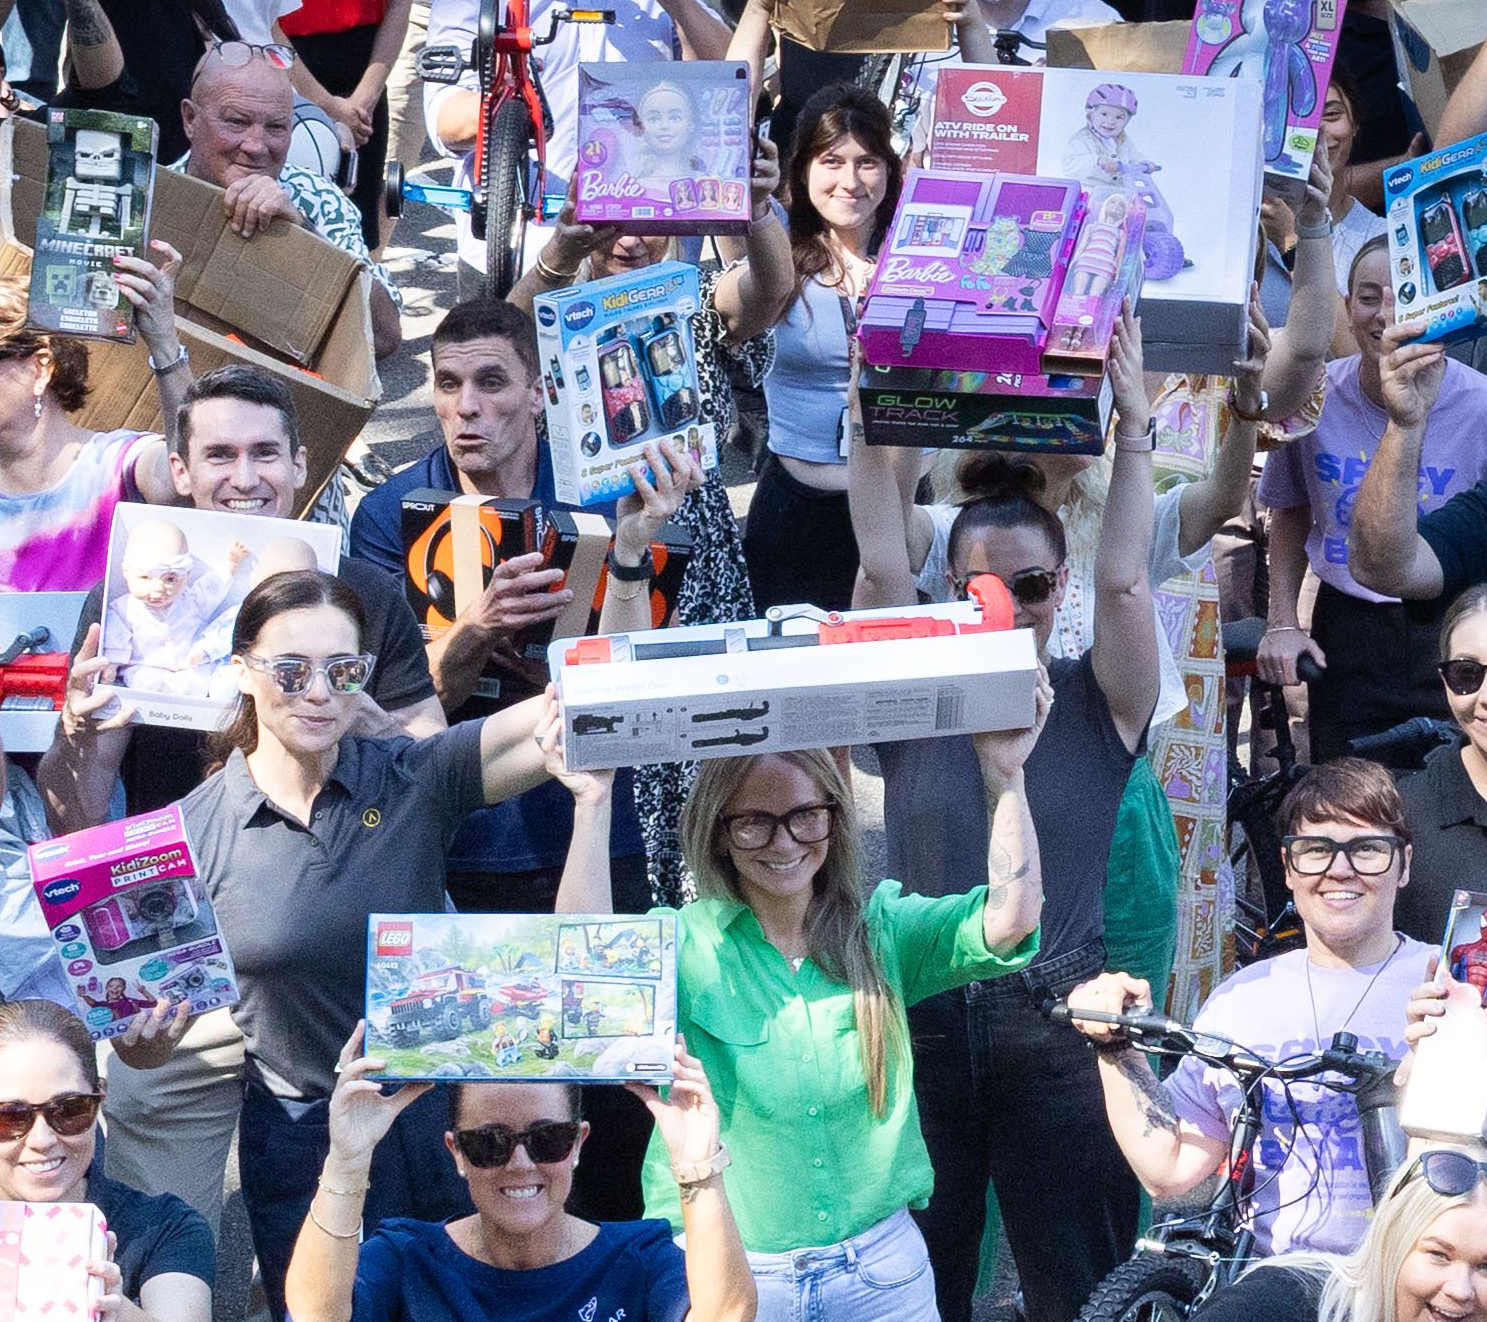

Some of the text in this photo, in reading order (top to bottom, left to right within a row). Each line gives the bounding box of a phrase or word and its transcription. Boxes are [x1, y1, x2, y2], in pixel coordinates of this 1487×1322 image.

[1320, 0, 1334, 12] XL
[935, 121, 1018, 134] ATV RIDE ON
[934, 129, 1030, 143] WITH TRAILER
[581, 171, 644, 200] Barbie
[1387, 174, 1412, 189] vtech
[39, 239, 135, 258] MINECRAFT
[70, 258, 103, 268] MOVIE
[882, 258, 955, 284] Barbie
[62, 307, 100, 318] SKELETON
[565, 306, 595, 325] vtech
[1404, 296, 1460, 322] Super Features!
[876, 394, 957, 410] GLOW
[870, 407, 958, 423] TRACK
[952, 434, 973, 444] 264
[591, 461, 614, 476] Super
[401, 501, 436, 513] SPROUT
[148, 710, 194, 724] Baby Dolls
[110, 847, 183, 876] KidiZoom
[113, 859, 187, 885] PRINT CAM
[42, 881, 81, 900] vtech
[378, 931, 410, 946] LEGO
